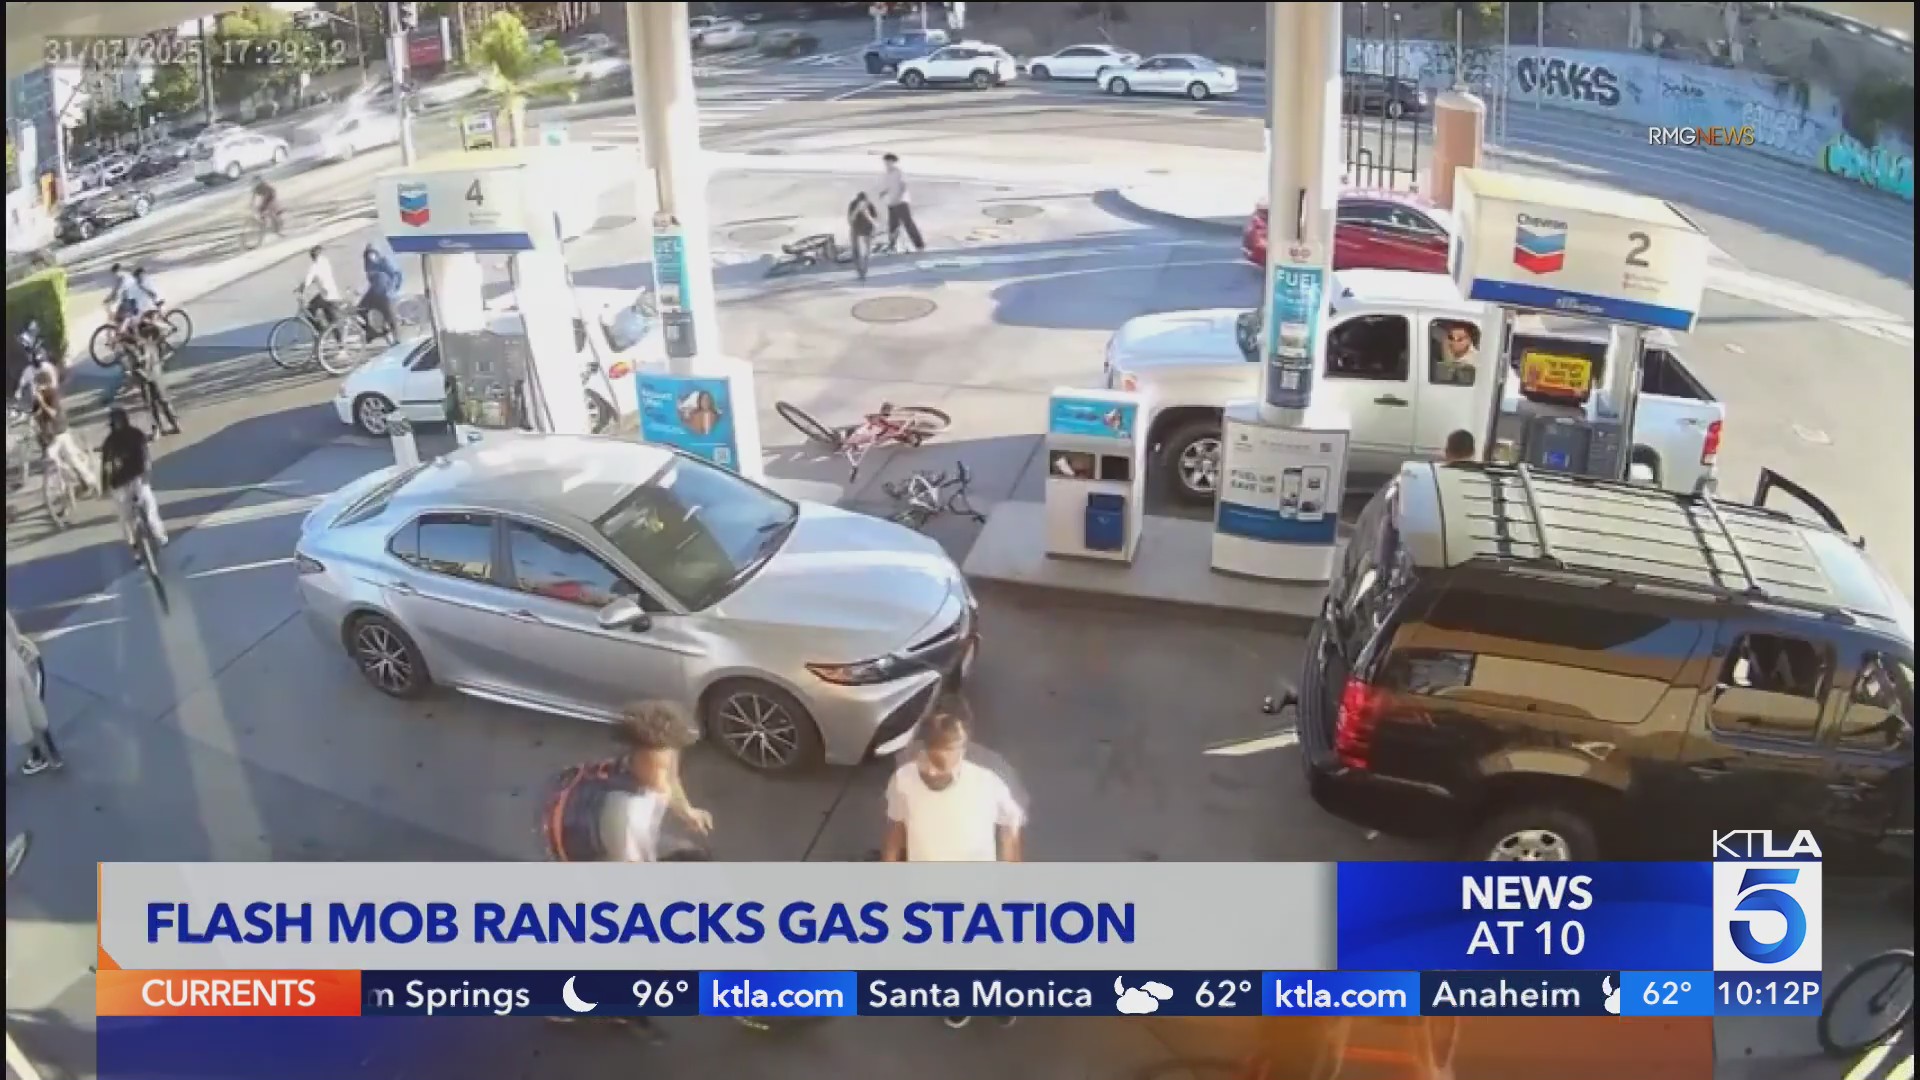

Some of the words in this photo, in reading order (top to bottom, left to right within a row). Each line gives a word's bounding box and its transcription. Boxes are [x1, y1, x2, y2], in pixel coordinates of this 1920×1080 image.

[465, 177, 485, 207] 4
[1516, 212, 1568, 231] Chevron
[1624, 230, 1652, 269] 2
